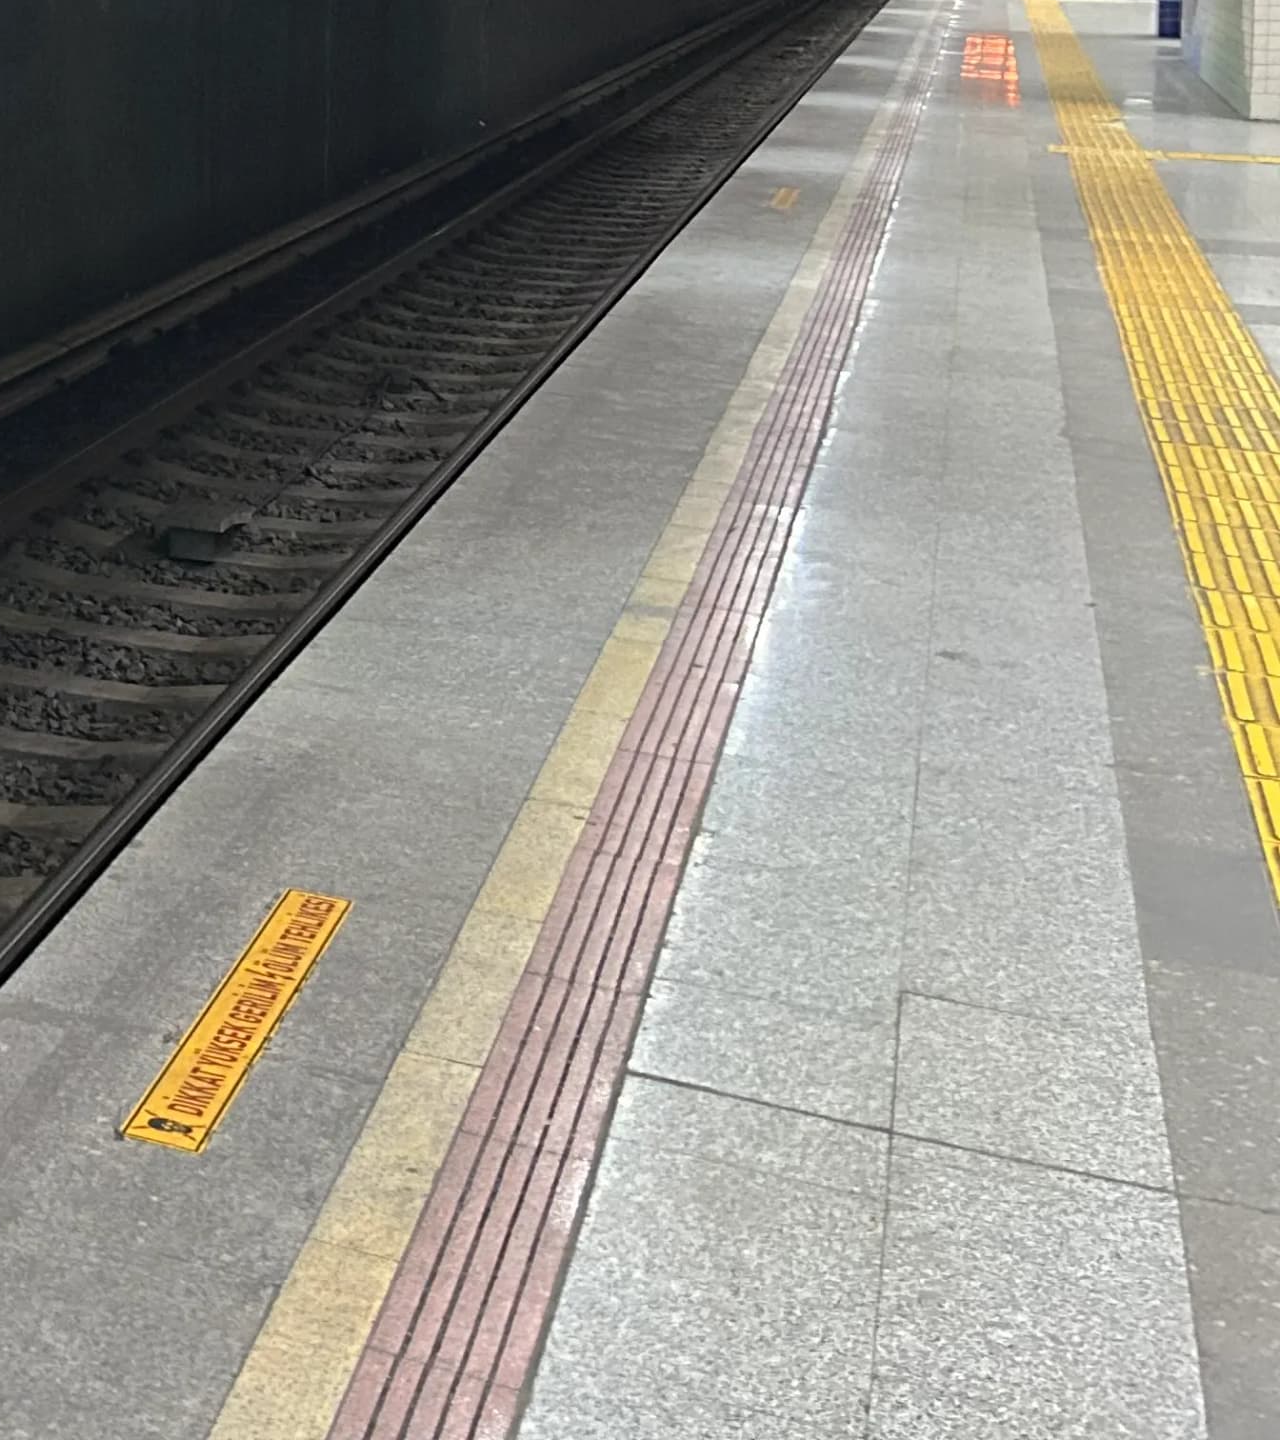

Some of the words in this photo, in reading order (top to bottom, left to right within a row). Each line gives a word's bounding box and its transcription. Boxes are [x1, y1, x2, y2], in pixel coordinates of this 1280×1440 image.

[280, 894, 337, 944] TEHLİKESİ
[253, 942, 308, 973] ÖLÜM
[227, 977, 285, 1024] GERİLİM
[194, 1021, 257, 1069] YÜKSEK
[162, 1066, 226, 1117] DİKKAT
